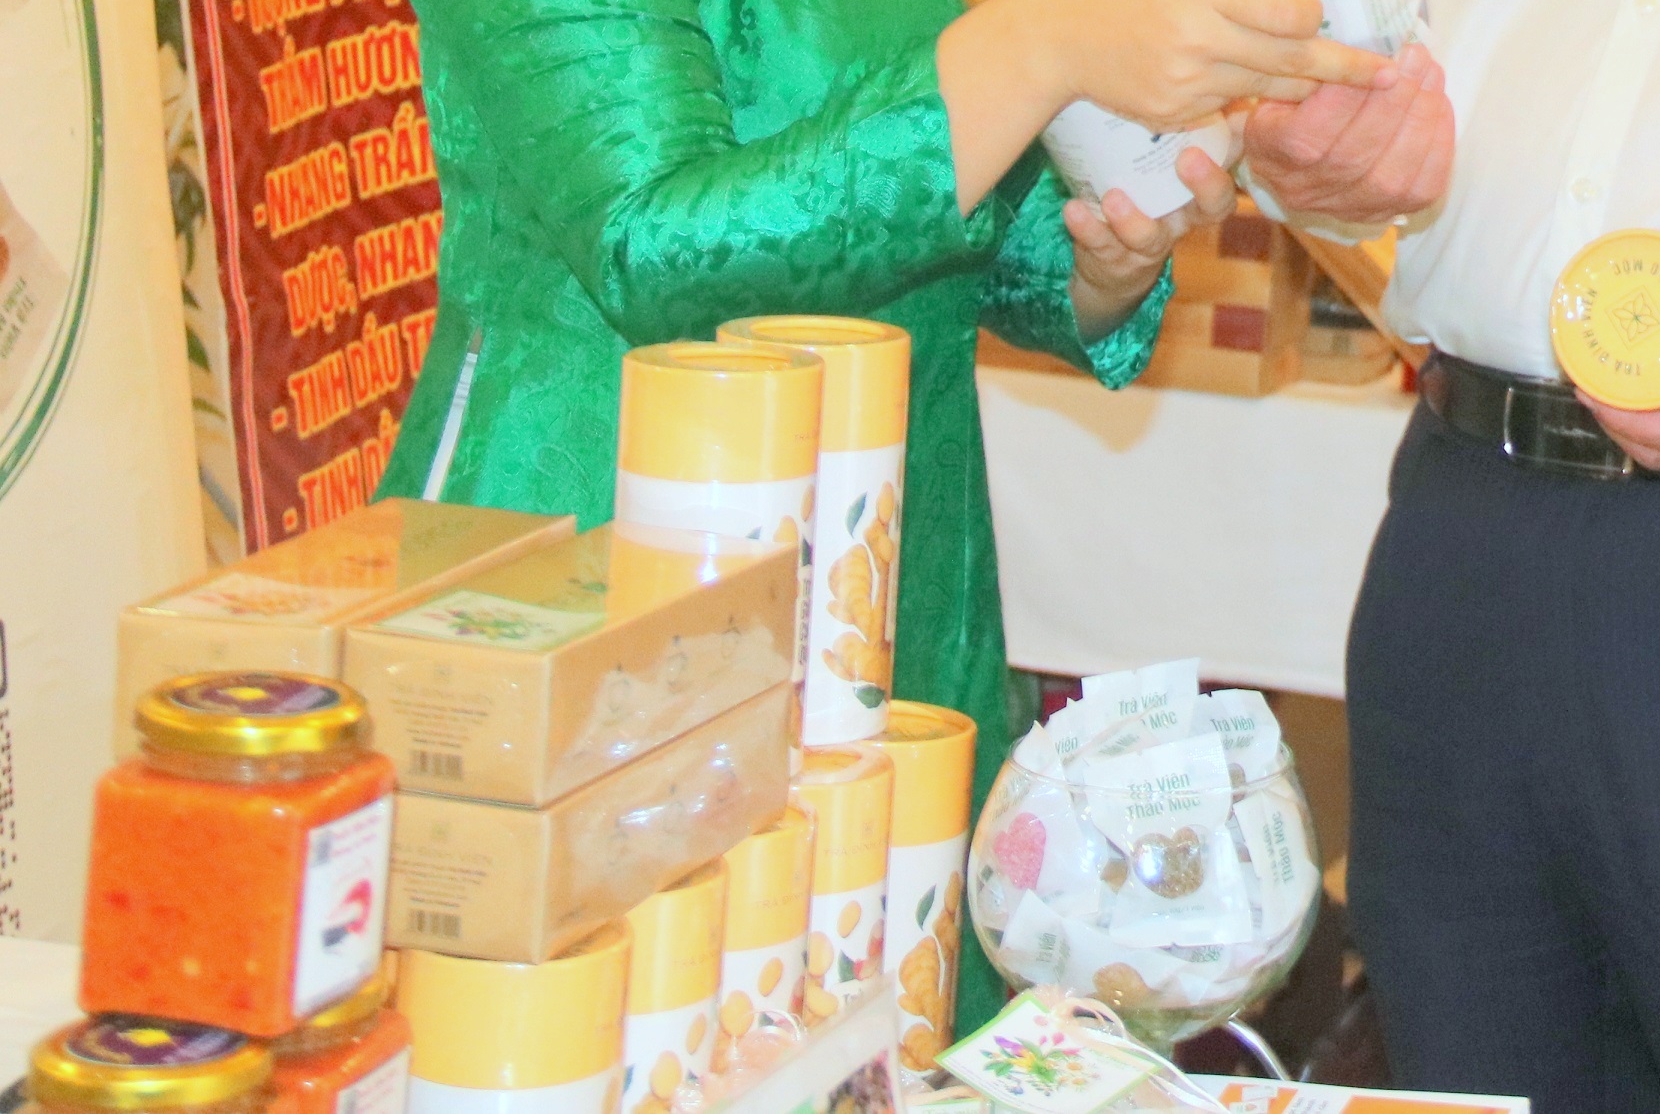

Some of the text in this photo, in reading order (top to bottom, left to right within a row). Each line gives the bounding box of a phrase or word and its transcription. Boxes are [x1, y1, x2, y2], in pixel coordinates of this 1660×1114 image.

[288, 350, 352, 439] TINH
[1118, 695, 1138, 717] Trà
[1156, 772, 1190, 792] Viên
